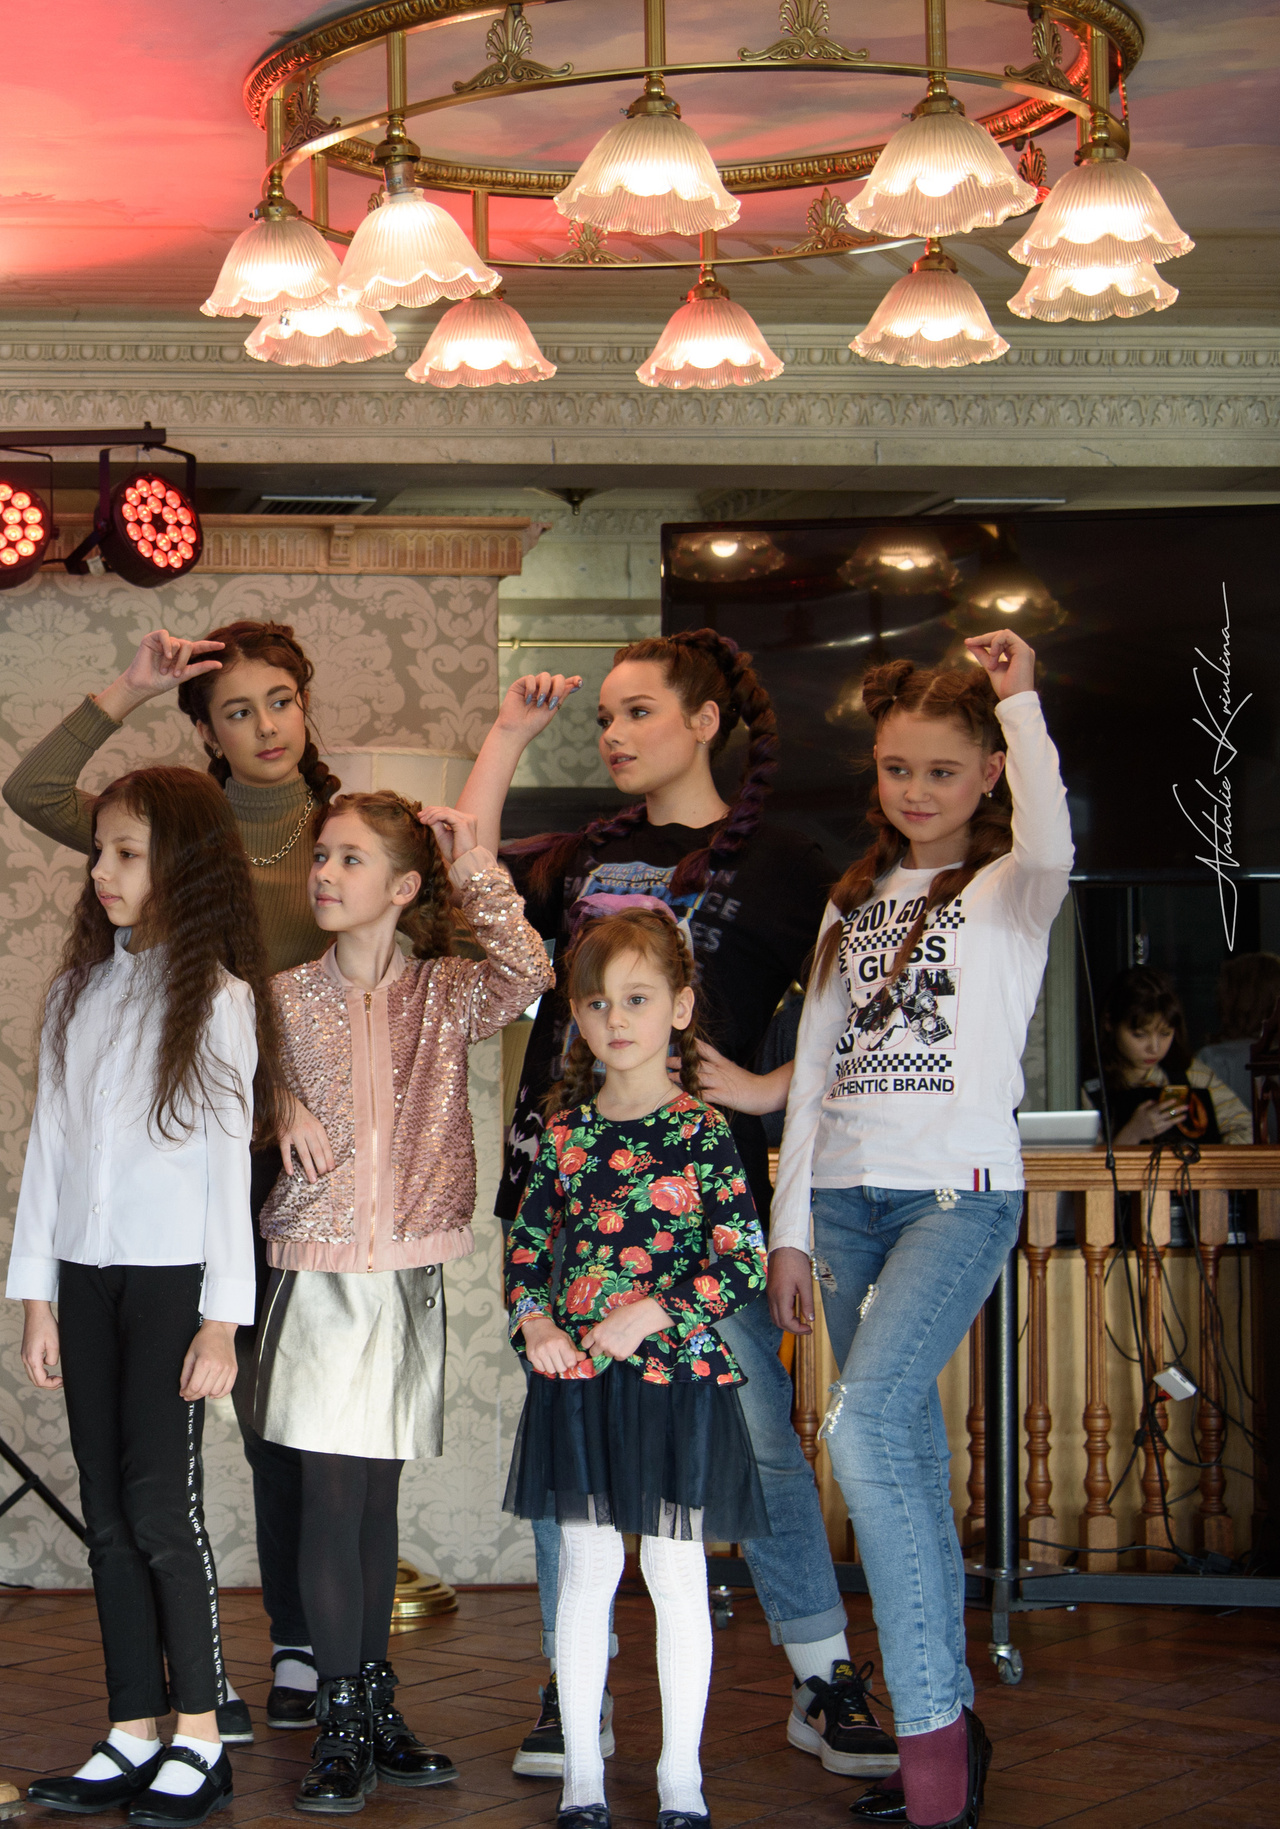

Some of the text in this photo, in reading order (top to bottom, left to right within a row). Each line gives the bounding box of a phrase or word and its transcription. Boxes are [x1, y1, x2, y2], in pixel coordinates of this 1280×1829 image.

[856, 899, 897, 932] GO!
[858, 935, 947, 983] GUSS
[892, 1077, 955, 1093] BRAND
